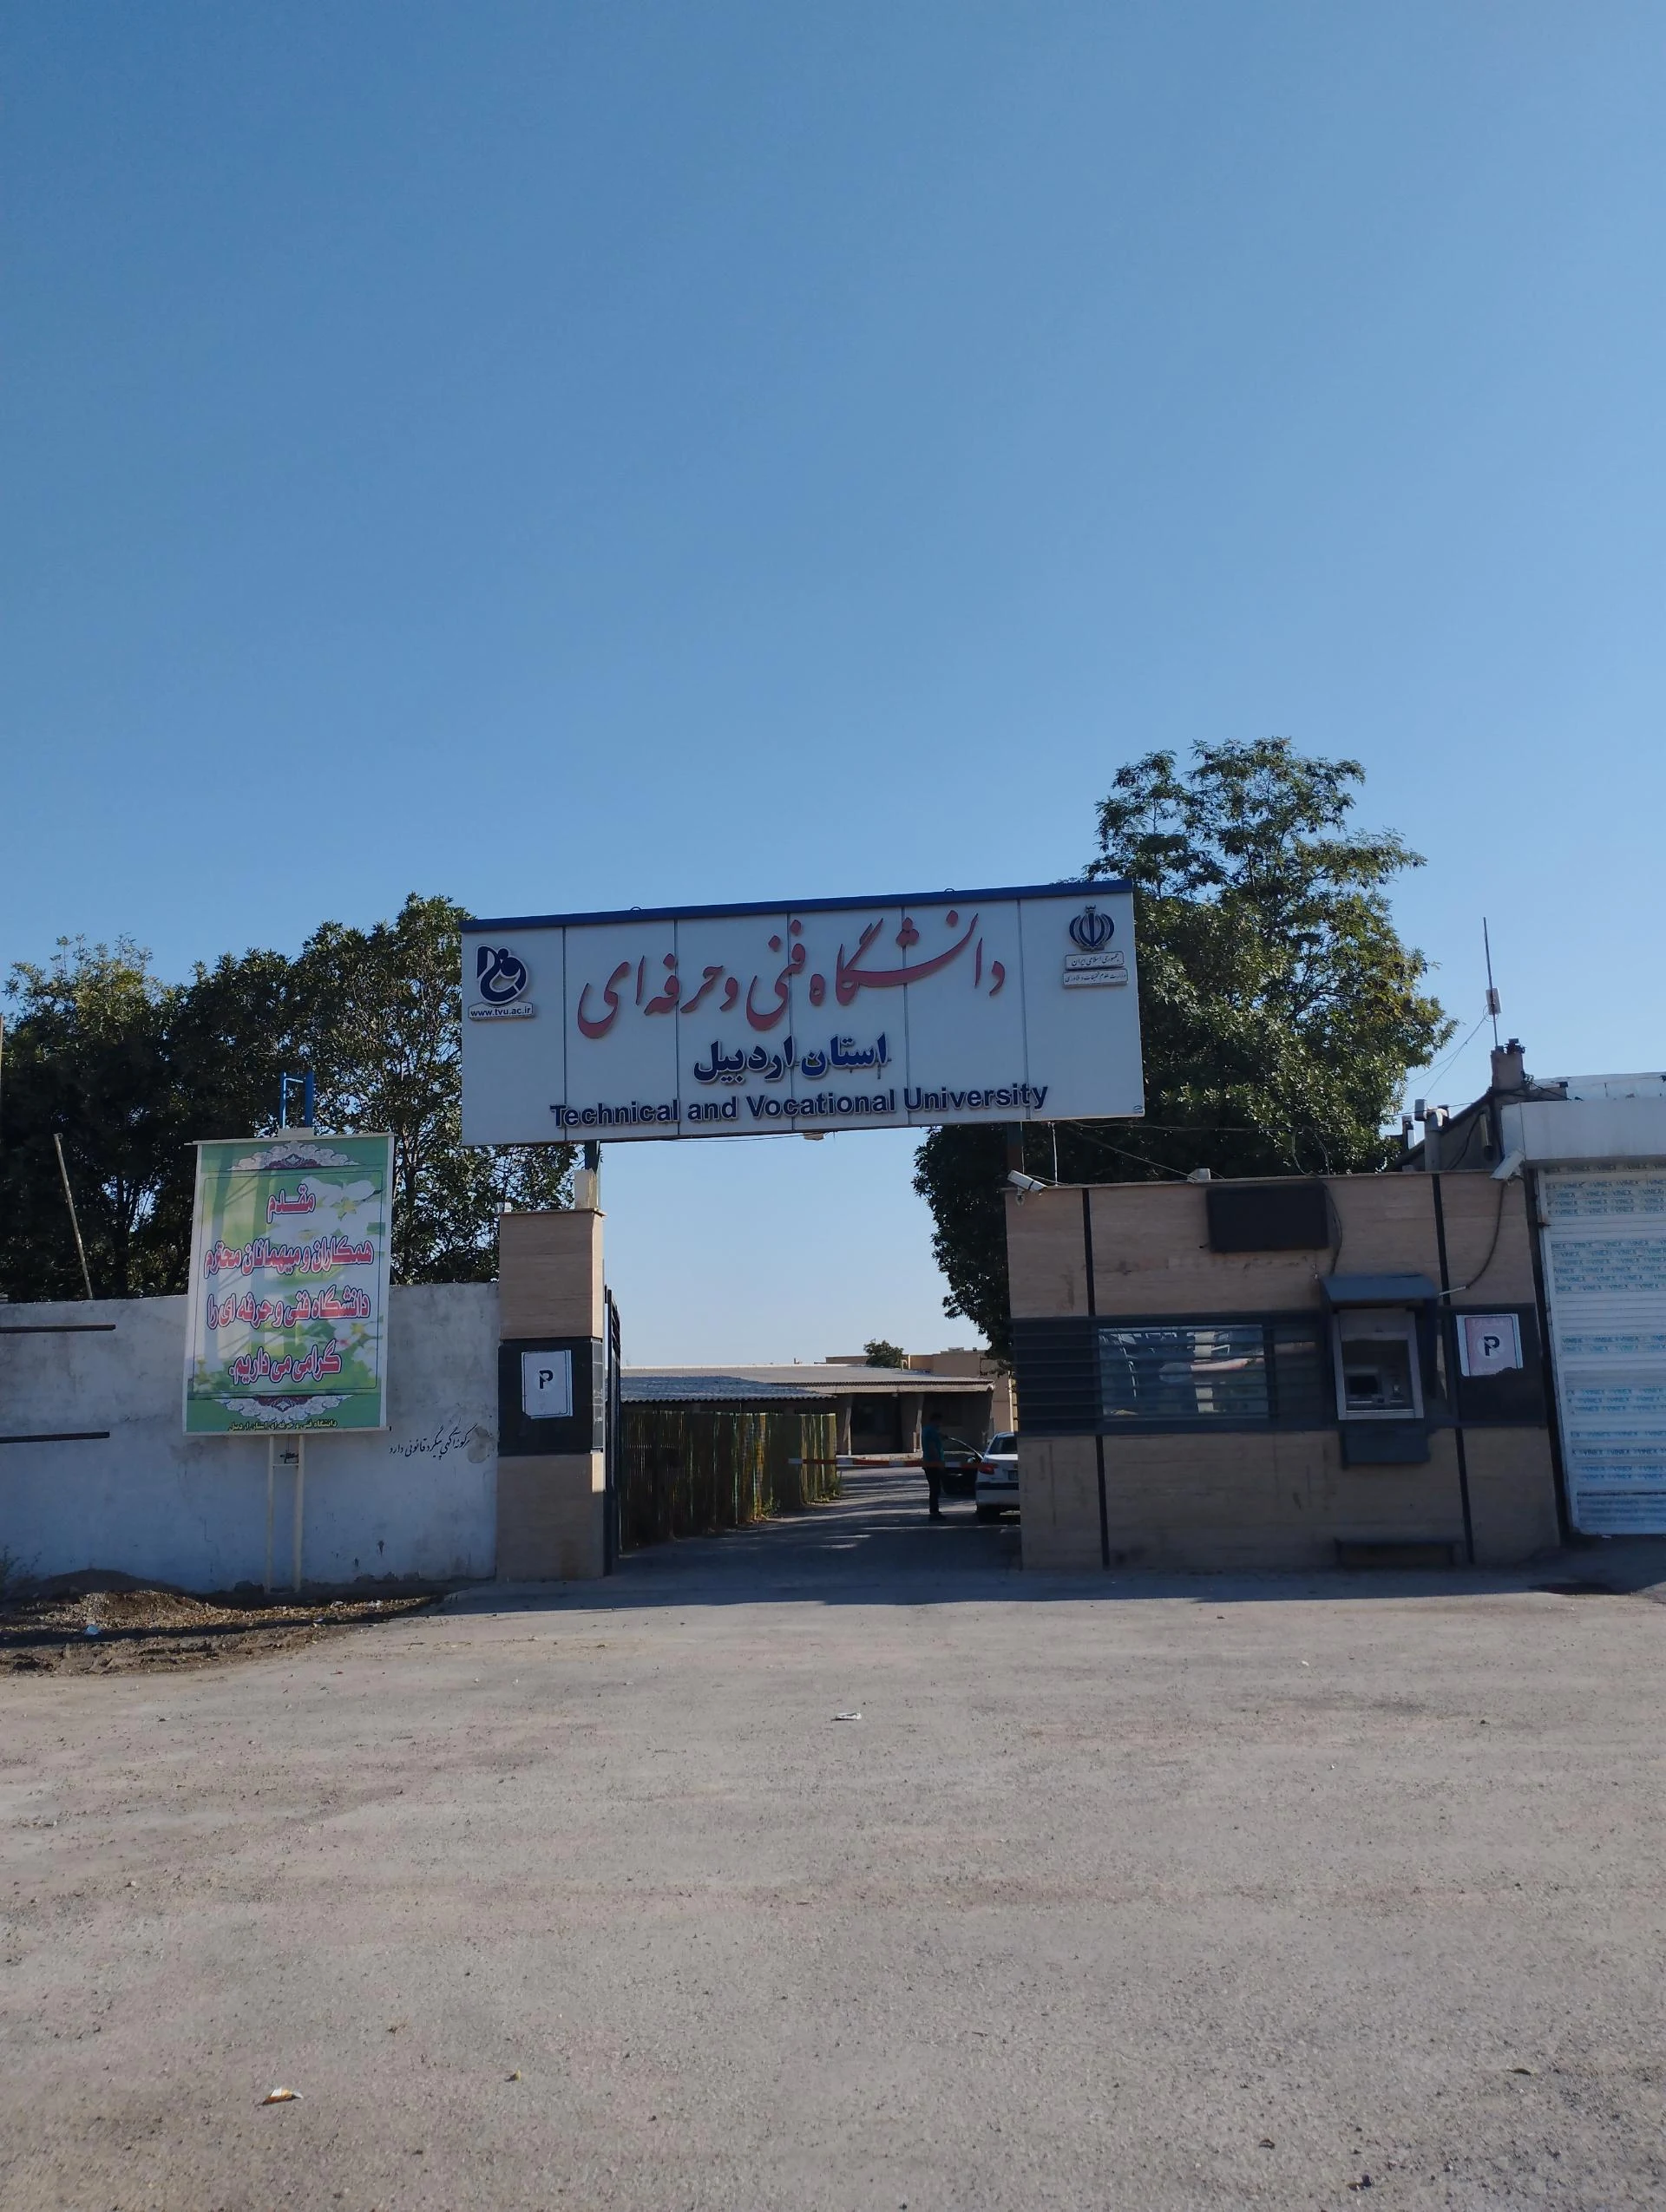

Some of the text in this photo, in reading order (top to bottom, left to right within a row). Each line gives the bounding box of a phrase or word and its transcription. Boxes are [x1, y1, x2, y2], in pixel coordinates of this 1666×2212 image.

[746, 919, 806, 1031] فنی
[809, 909, 1006, 1006] دانشگاه
[469, 1005, 532, 1017] www.tvu.ac.ir
[693, 1031, 889, 1083] استان اردبیل
[548, 1082, 1049, 1128] Technical and Vocational University
[204, 1235, 375, 1279] همکاران و میهمانان محترم
[207, 1293, 220, 1330] را
[236, 1291, 273, 1330] حرفه
[272, 1300, 284, 1328] و
[284, 1290, 312, 1328] فنی
[312, 1284, 371, 1320] دانشگاه
[292, 1338, 342, 1382] گرامی
[1483, 1336, 1500, 1357] P
[270, 1354, 292, 1383] می
[538, 1369, 554, 1390] P
